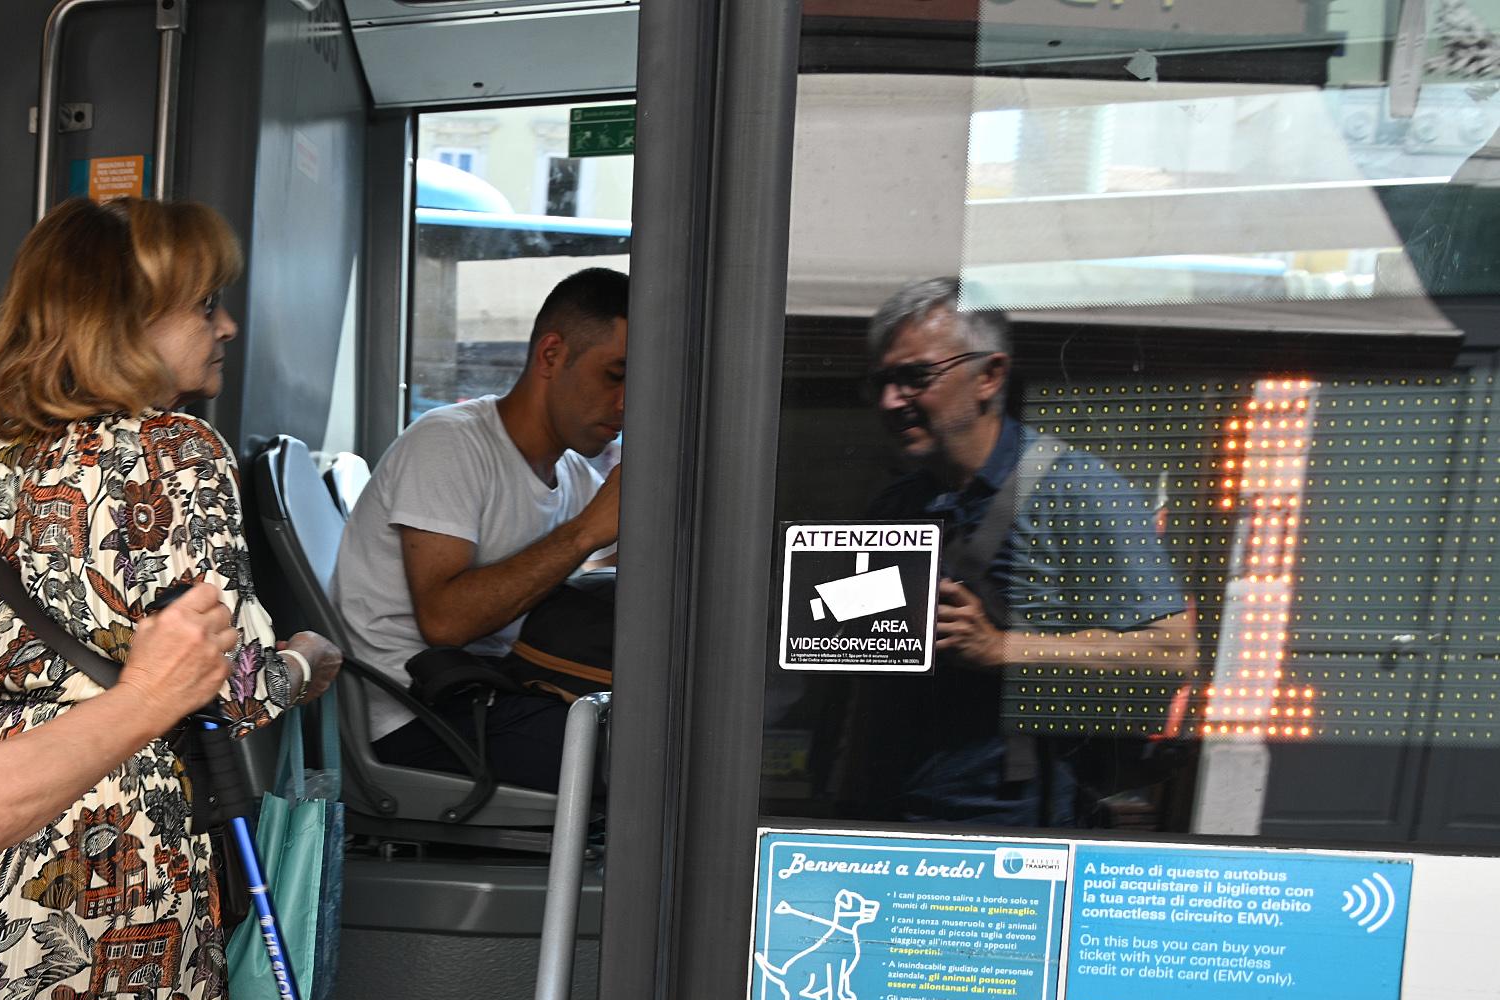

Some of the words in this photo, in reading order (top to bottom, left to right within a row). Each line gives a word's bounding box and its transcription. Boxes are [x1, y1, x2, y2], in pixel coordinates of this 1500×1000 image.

[791, 530, 933, 546] ATTENZIONE
[871, 620, 909, 633] AREA
[789, 637, 923, 651] VIDEOSORVEGLIATA
[778, 852, 891, 880] Benvenuti
[896, 863, 909, 876] a
[914, 859, 984, 879] bordo!
[1084, 862, 1096, 875] A
[1100, 863, 1144, 877] bordo
[1148, 865, 1163, 877] di
[1166, 867, 1220, 880] questo
[1223, 868, 1288, 882] autobus
[1083, 878, 1116, 891] puoi
[1120, 878, 1199, 893] acquistare
[1204, 881, 1212, 893] il
[1216, 882, 1281, 898] biglietto
[1285, 887, 1314, 898] con
[916, 893, 950, 903] possono
[952, 893, 974, 902] salire
[983, 895, 1008, 904] bordo
[1010, 897, 1027, 905] solo
[1083, 890, 1096, 904] la
[1100, 892, 1124, 904] tua
[1127, 894, 1166, 906] carta
[1170, 895, 1185, 907] di
[1188, 896, 1243, 909] credito
[1247, 900, 1258, 910] o
[1261, 898, 1312, 913] debito
[892, 901, 918, 910] muniti
[920, 902, 928, 910] di
[930, 903, 978, 913] museruola
[987, 906, 1038, 917] guinzaglio.
[1081, 906, 1166, 921] contactless
[1170, 910, 1233, 924] (circuito
[1237, 911, 1284, 927] EMV).
[897, 916, 914, 924] cani
[916, 918, 939, 926] senza
[942, 918, 984, 928] museruola
[995, 921, 1005, 931] gli
[1008, 922, 1037, 931] animali
[938, 928, 946, 936] di
[949, 929, 978, 939] piccola
[981, 931, 1003, 940] taglia
[1005, 932, 1037, 941] devono
[890, 936, 927, 947] viaggiare
[929, 938, 971, 948] all'interno
[974, 940, 981, 948] di
[984, 941, 1017, 950] appositi
[1080, 933, 1100, 947] On
[1104, 935, 1129, 948] this
[1132, 937, 1158, 949] bus
[1162, 939, 1188, 954] you
[1191, 941, 1218, 952] can
[1222, 940, 1251, 956] buy
[1253, 944, 1287, 956] your
[1079, 949, 1116, 961] ticket
[1120, 951, 1150, 963] with
[1155, 954, 1186, 967] your
[1189, 955, 1272, 970] contactless
[897, 961, 947, 971] insindacabile
[948, 964, 979, 974] giudizio
[981, 966, 993, 974] del
[995, 968, 1033, 977] personale
[1078, 963, 1117, 976] credit
[1120, 965, 1135, 977] or
[1138, 966, 1174, 979] debit
[1177, 968, 1209, 981] card
[1213, 969, 1252, 983] (EMV
[1256, 971, 1296, 986] only).
[887, 981, 916, 989] essere
[919, 982, 968, 993] allontanati
[971, 985, 984, 994] dai
[987, 987, 1017, 995] mezzi.
[928, 973, 940, 982] gli
[942, 974, 977, 983] animali
[978, 976, 1017, 987] possono
